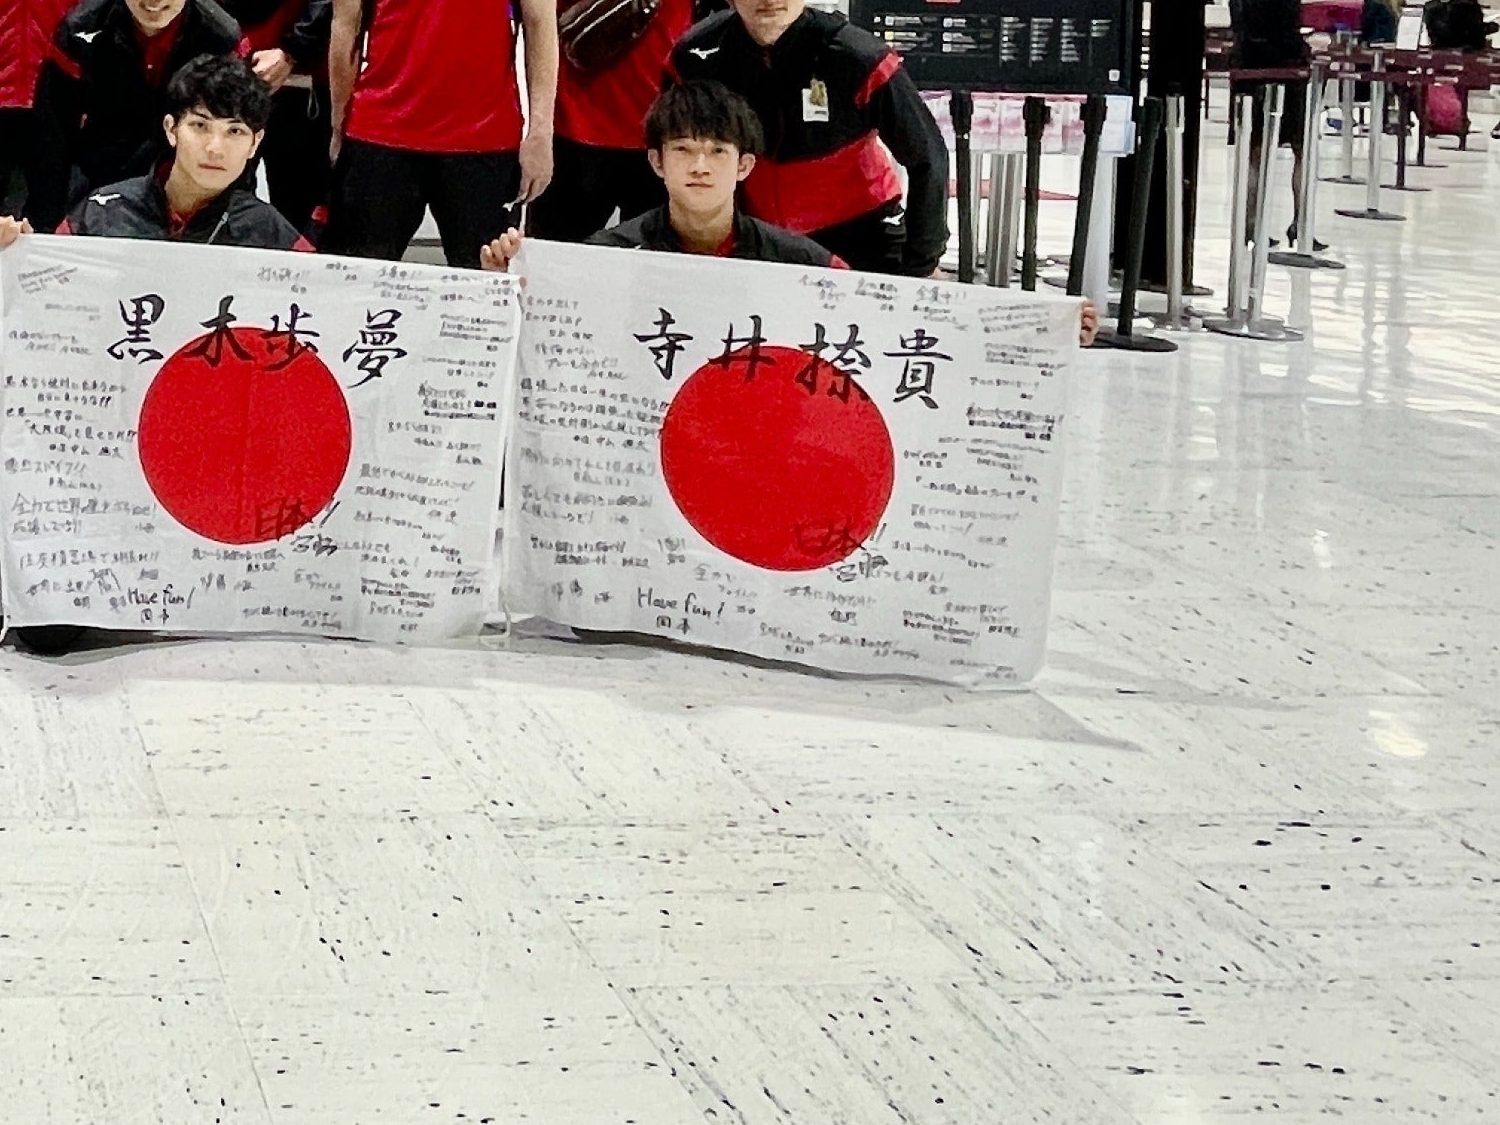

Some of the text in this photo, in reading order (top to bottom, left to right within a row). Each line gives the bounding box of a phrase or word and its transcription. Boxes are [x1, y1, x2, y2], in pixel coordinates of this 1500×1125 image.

[106, 293, 408, 389] 黒木歩夢
[637, 586, 727, 626] Have fun!
